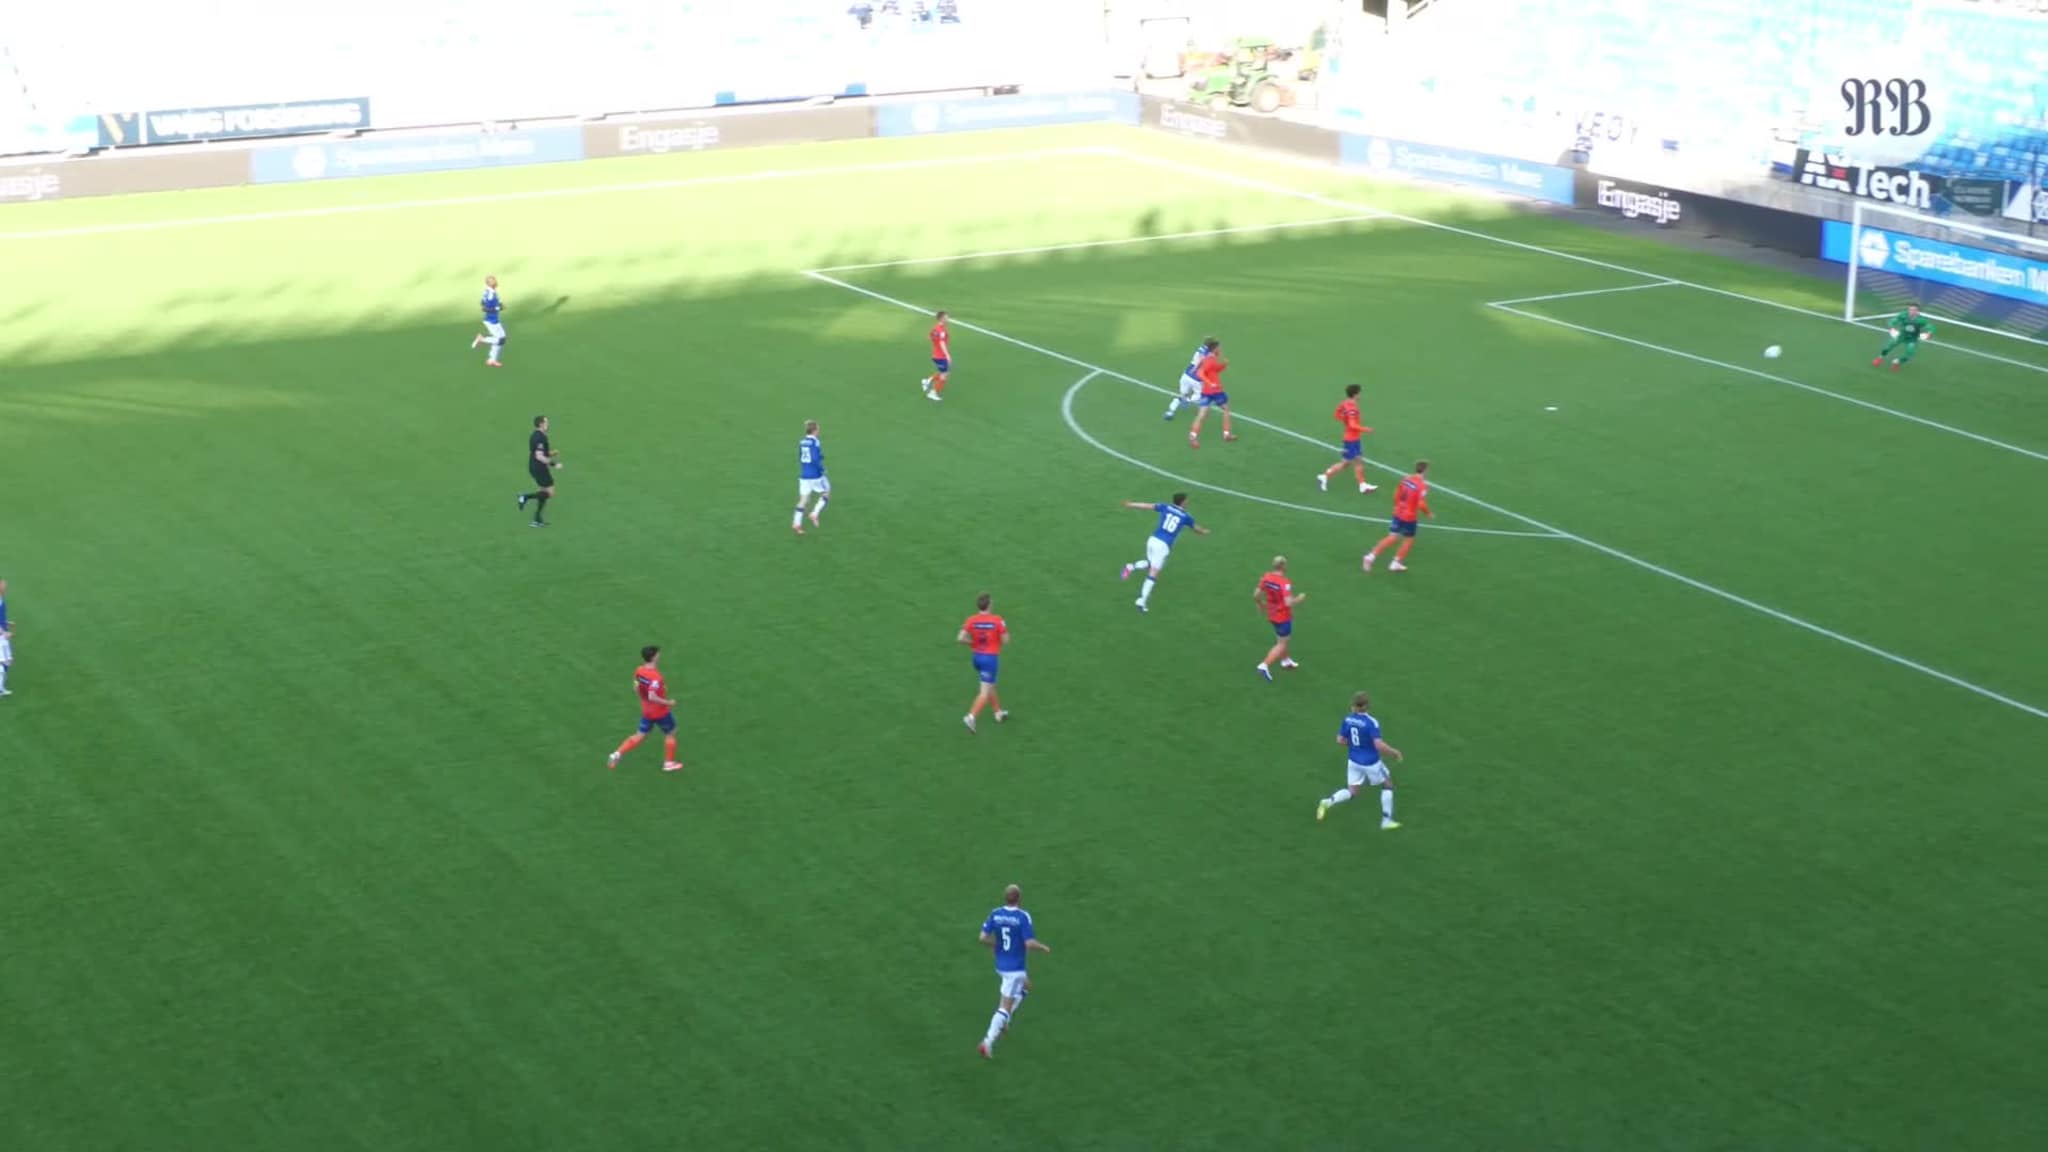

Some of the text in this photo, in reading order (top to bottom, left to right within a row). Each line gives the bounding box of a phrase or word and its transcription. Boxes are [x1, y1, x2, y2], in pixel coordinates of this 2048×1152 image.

[618, 120, 719, 152] Engasje
[1597, 179, 1682, 224] Engasje
[1893, 240, 2025, 288] Sparebanken
[1162, 513, 1181, 533] 16
[1001, 926, 1011, 951] 5
